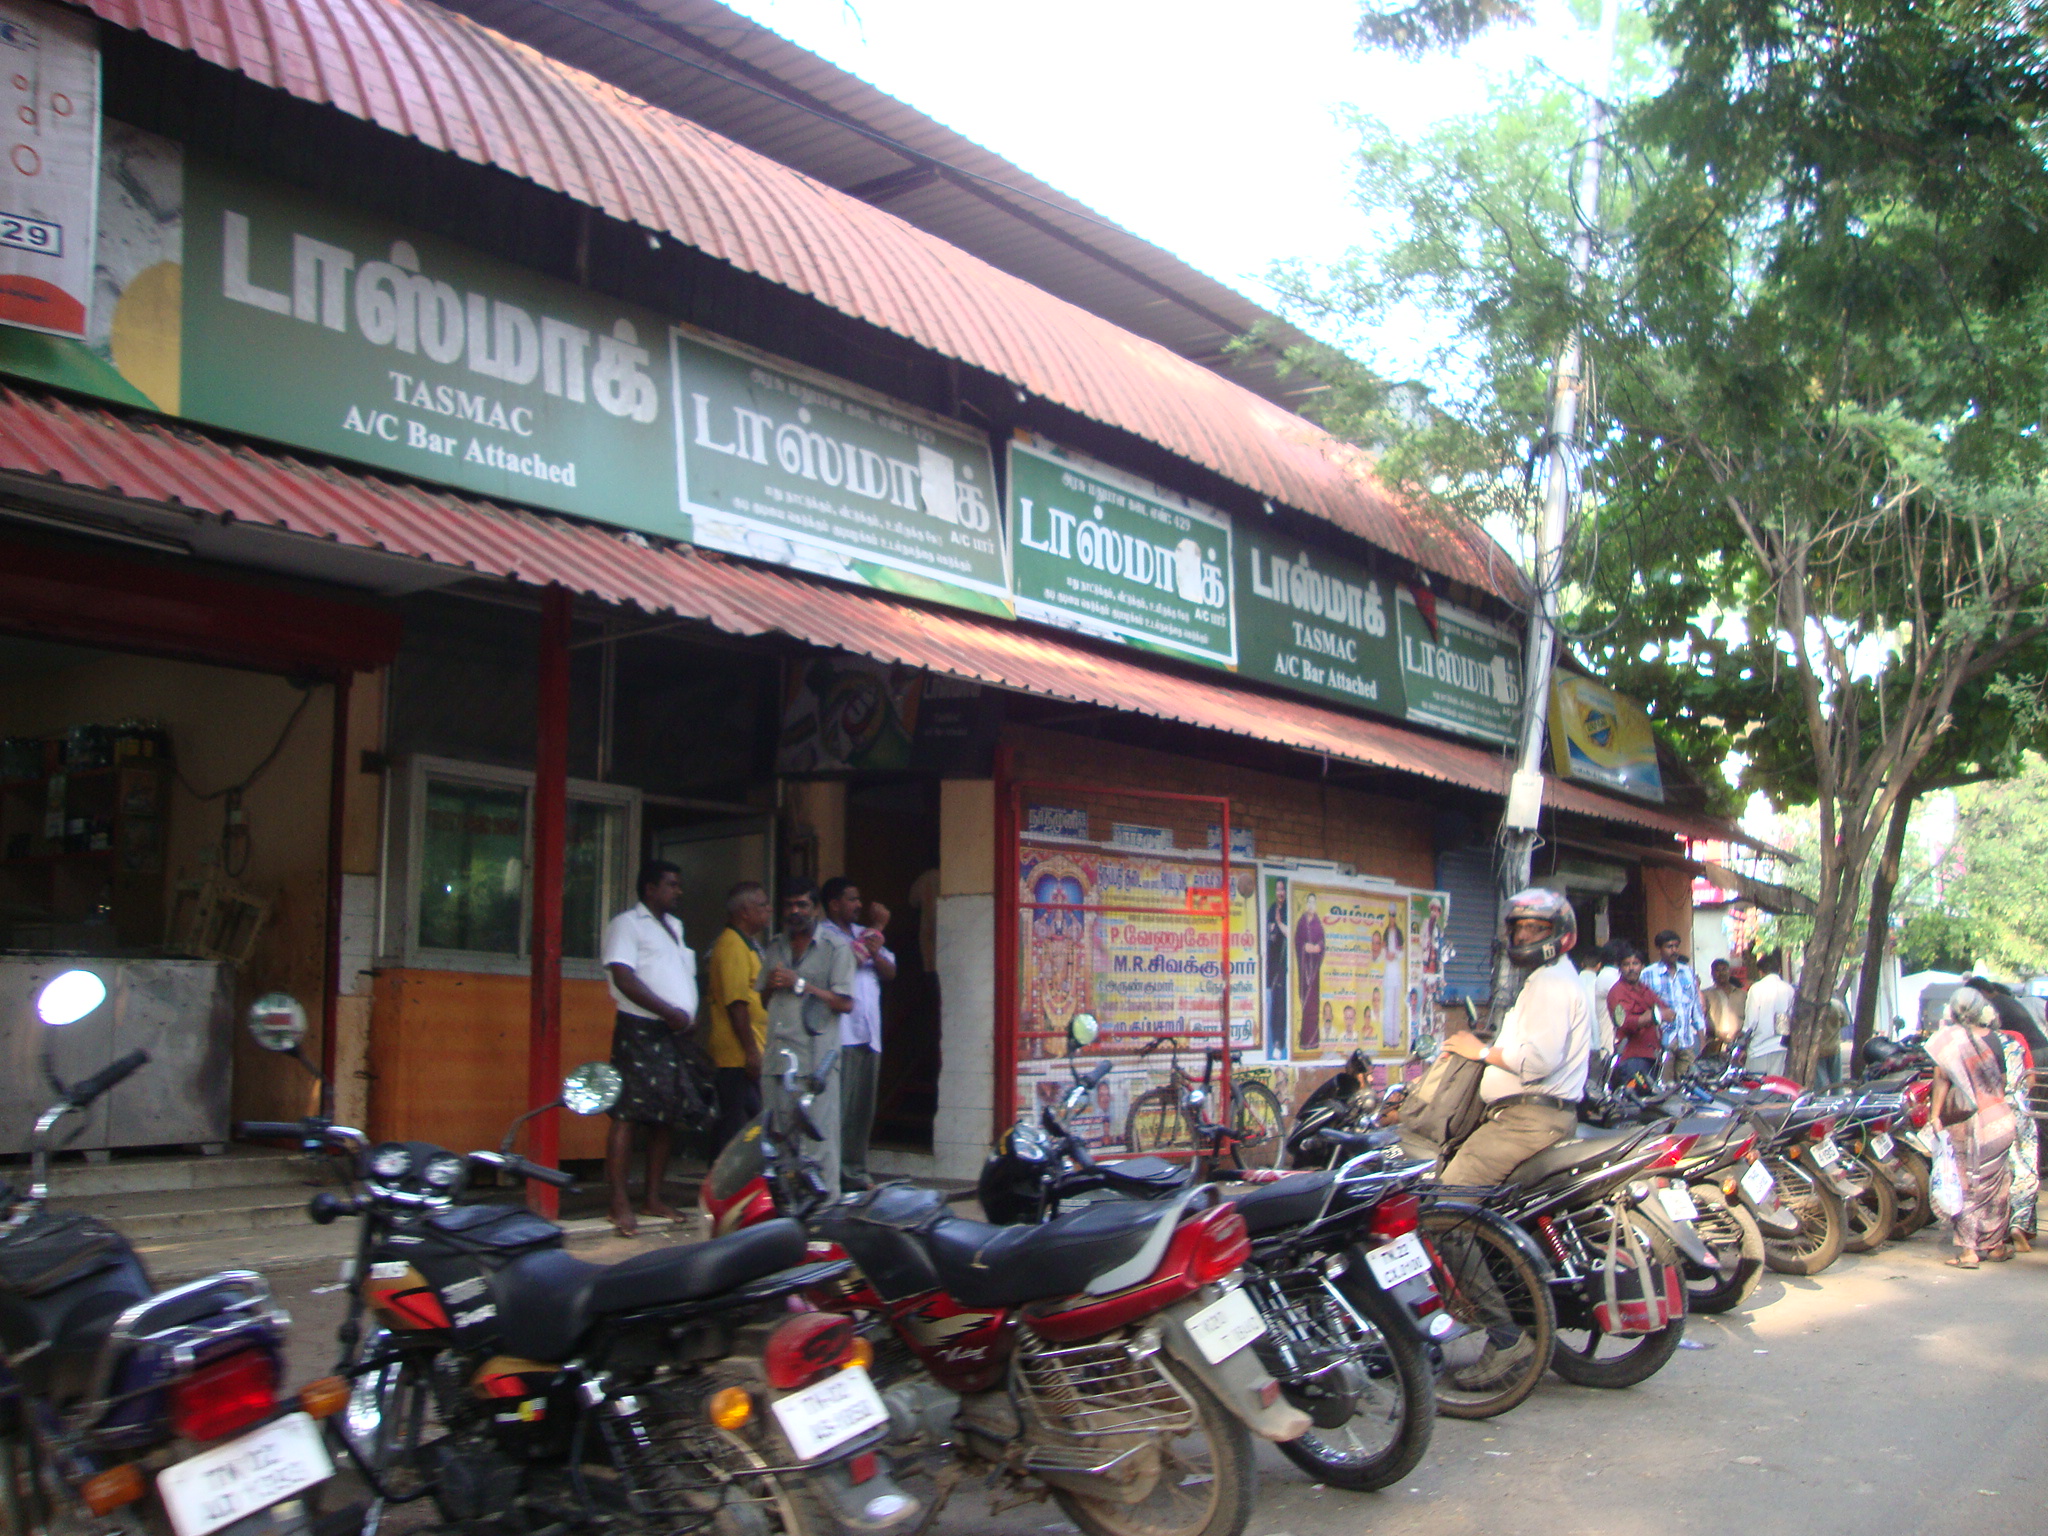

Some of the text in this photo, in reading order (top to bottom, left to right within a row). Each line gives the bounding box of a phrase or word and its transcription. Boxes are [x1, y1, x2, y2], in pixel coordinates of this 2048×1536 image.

[223, 209, 659, 425] டாஸ்மாக்
[389, 370, 533, 437] TASMAC
[342, 404, 577, 487] A/C Bar Attached
[951, 529, 971, 548] A/C
[1194, 606, 1210, 623] A/C
[1251, 547, 1386, 638] டாஸ்மாக்
[1292, 621, 1357, 664] TASMAC
[1274, 653, 1377, 700] A/C Bar Attached
